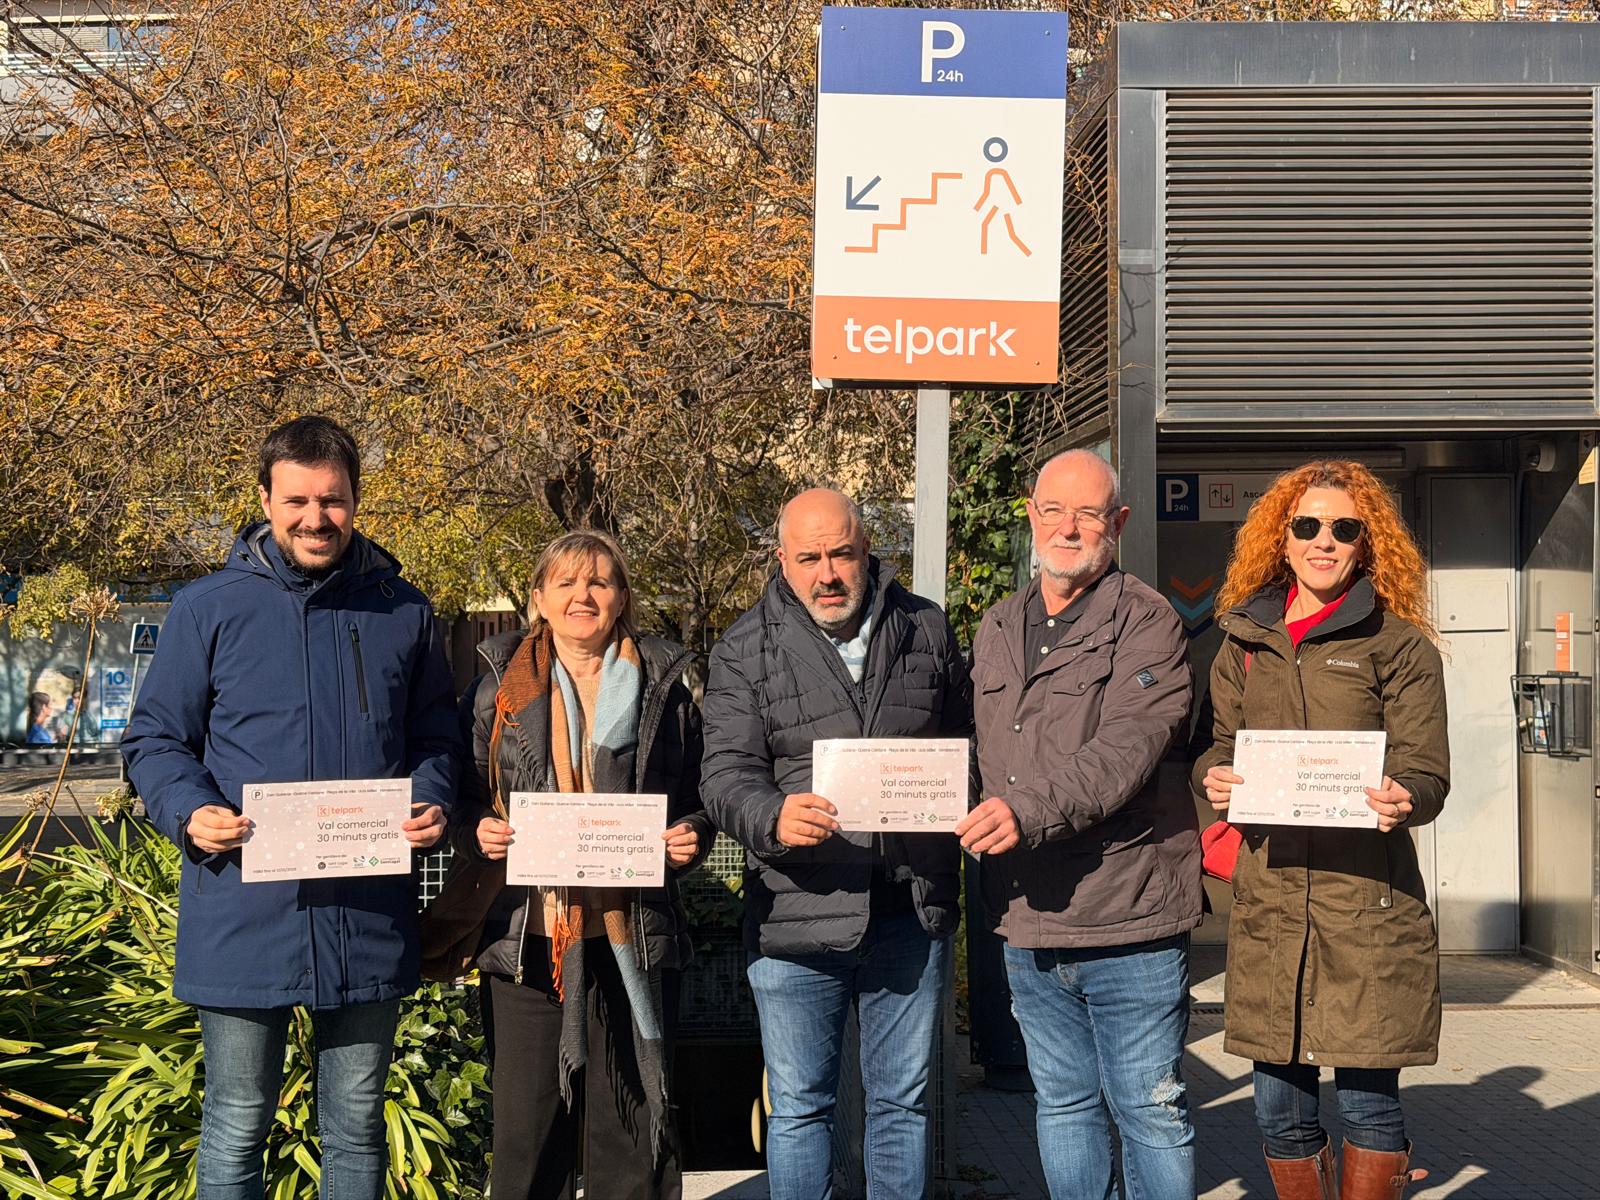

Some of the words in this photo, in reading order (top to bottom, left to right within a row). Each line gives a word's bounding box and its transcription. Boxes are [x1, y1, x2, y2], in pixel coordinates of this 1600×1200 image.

[921, 20, 966, 83] P
[937, 69, 964, 83] 24h
[843, 317, 1017, 364] telpark
[1165, 479, 1189, 513] P
[1174, 504, 1189, 512] 24h
[1332, 658, 1360, 669] Columbia
[1310, 757, 1339, 766] telpark
[893, 764, 924, 774] telpark
[1297, 771, 1312, 780] Val
[1313, 771, 1361, 781] comercial
[880, 778, 896, 787] Val
[898, 778, 947, 787] comercial
[1296, 783, 1307, 792] 30
[1308, 783, 1341, 793] minuts
[1343, 784, 1368, 795] grati
[880, 790, 892, 799] 30
[894, 790, 927, 799] minuts
[929, 790, 957, 801] gratis
[331, 805, 365, 816] telpark
[317, 821, 335, 831] Val
[336, 819, 389, 830] comercial
[591, 818, 622, 828] telpark
[316, 834, 330, 843] 30
[332, 832, 368, 842] minuts
[369, 831, 400, 842] gratis
[578, 832, 594, 841] Val
[595, 832, 645, 842] comercial
[577, 844, 589, 853] 30
[591, 844, 625, 853] minuts
[626, 844, 654, 856] gratis
